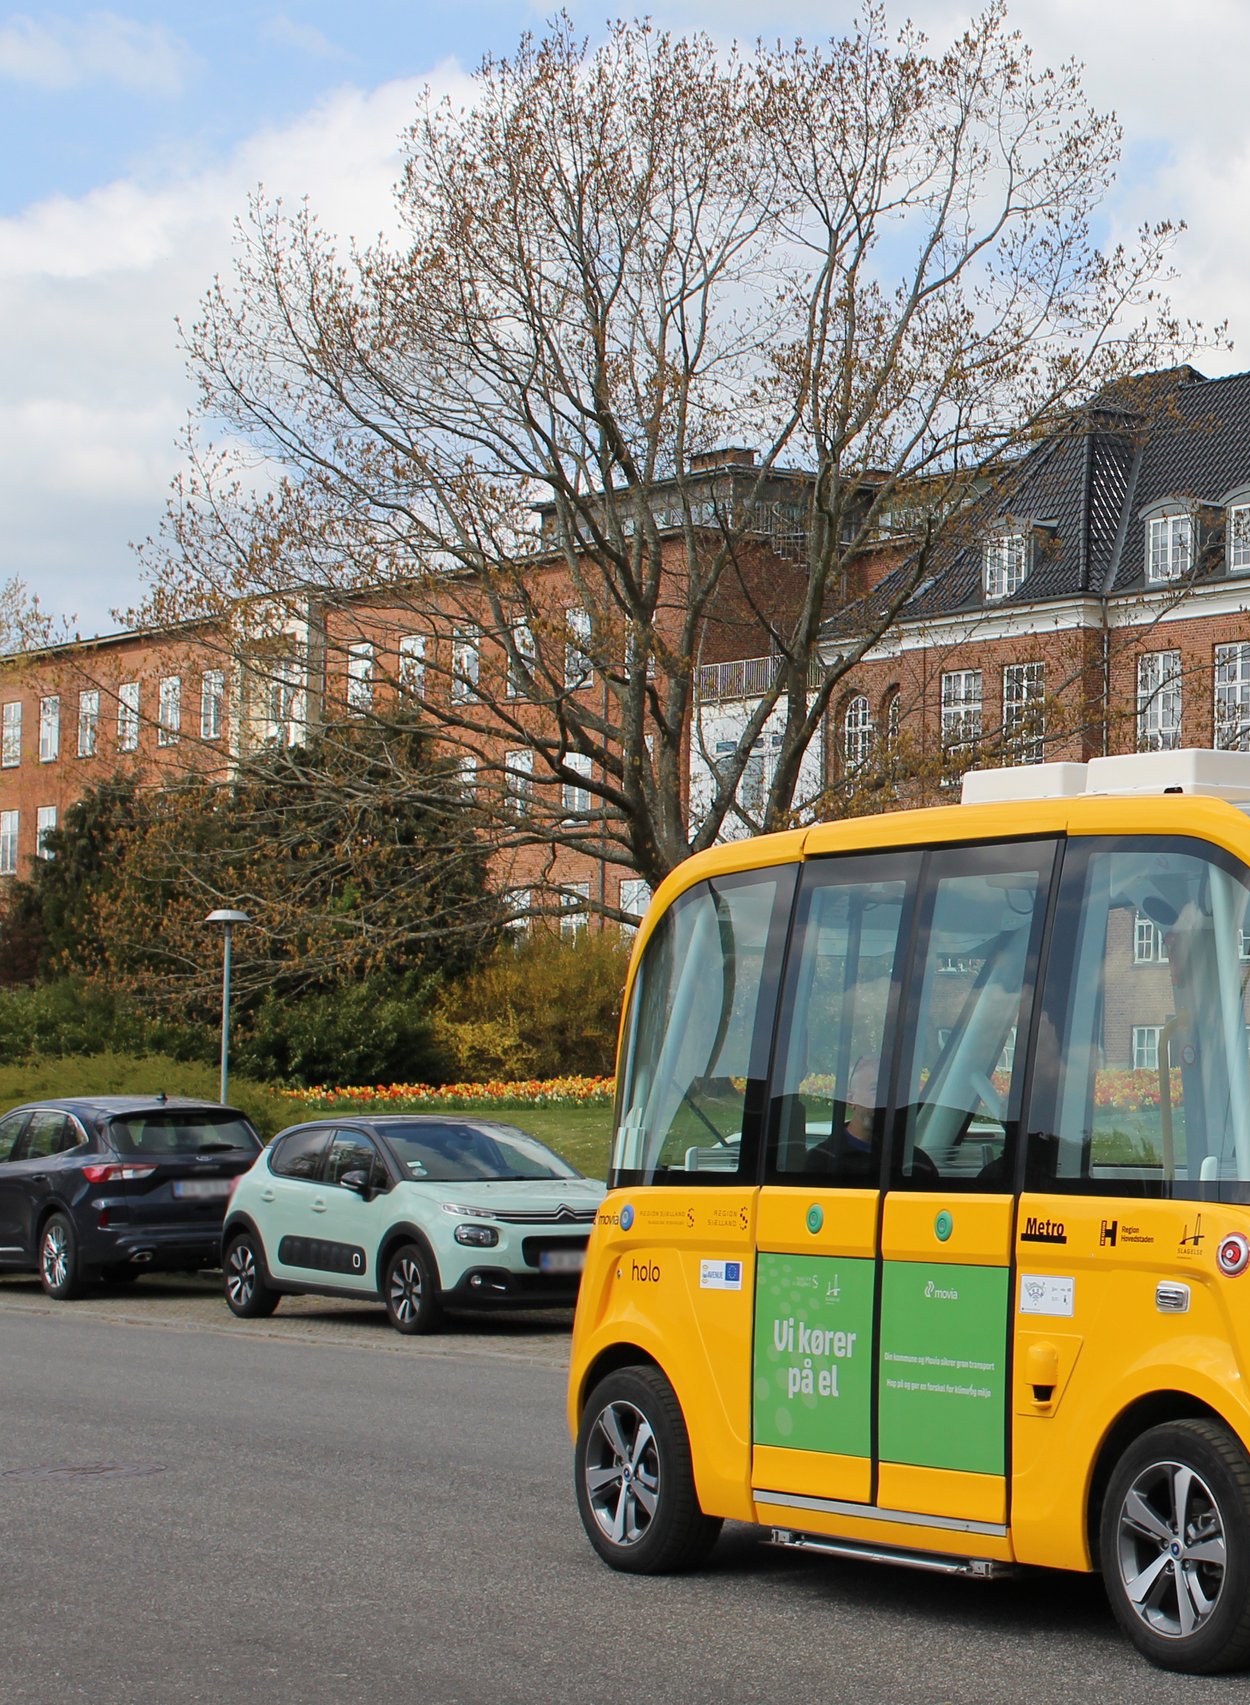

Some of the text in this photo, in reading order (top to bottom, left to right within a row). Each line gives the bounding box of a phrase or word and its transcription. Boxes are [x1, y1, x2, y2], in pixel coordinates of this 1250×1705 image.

[598, 1211, 619, 1225] movia
[713, 1209, 738, 1217] REGION
[1025, 1217, 1065, 1236] Metro
[1121, 1225, 1140, 1235] Region
[1121, 1234, 1154, 1244] Hovedstaden
[1177, 1248, 1203, 1256] SLAGELSE
[631, 1258, 661, 1282] holo
[934, 1287, 958, 1300] movia
[799, 1321, 857, 1358] kører
[925, 1356, 940, 1366] Movia
[969, 1360, 995, 1371] transport
[788, 1358, 839, 1399] på el
